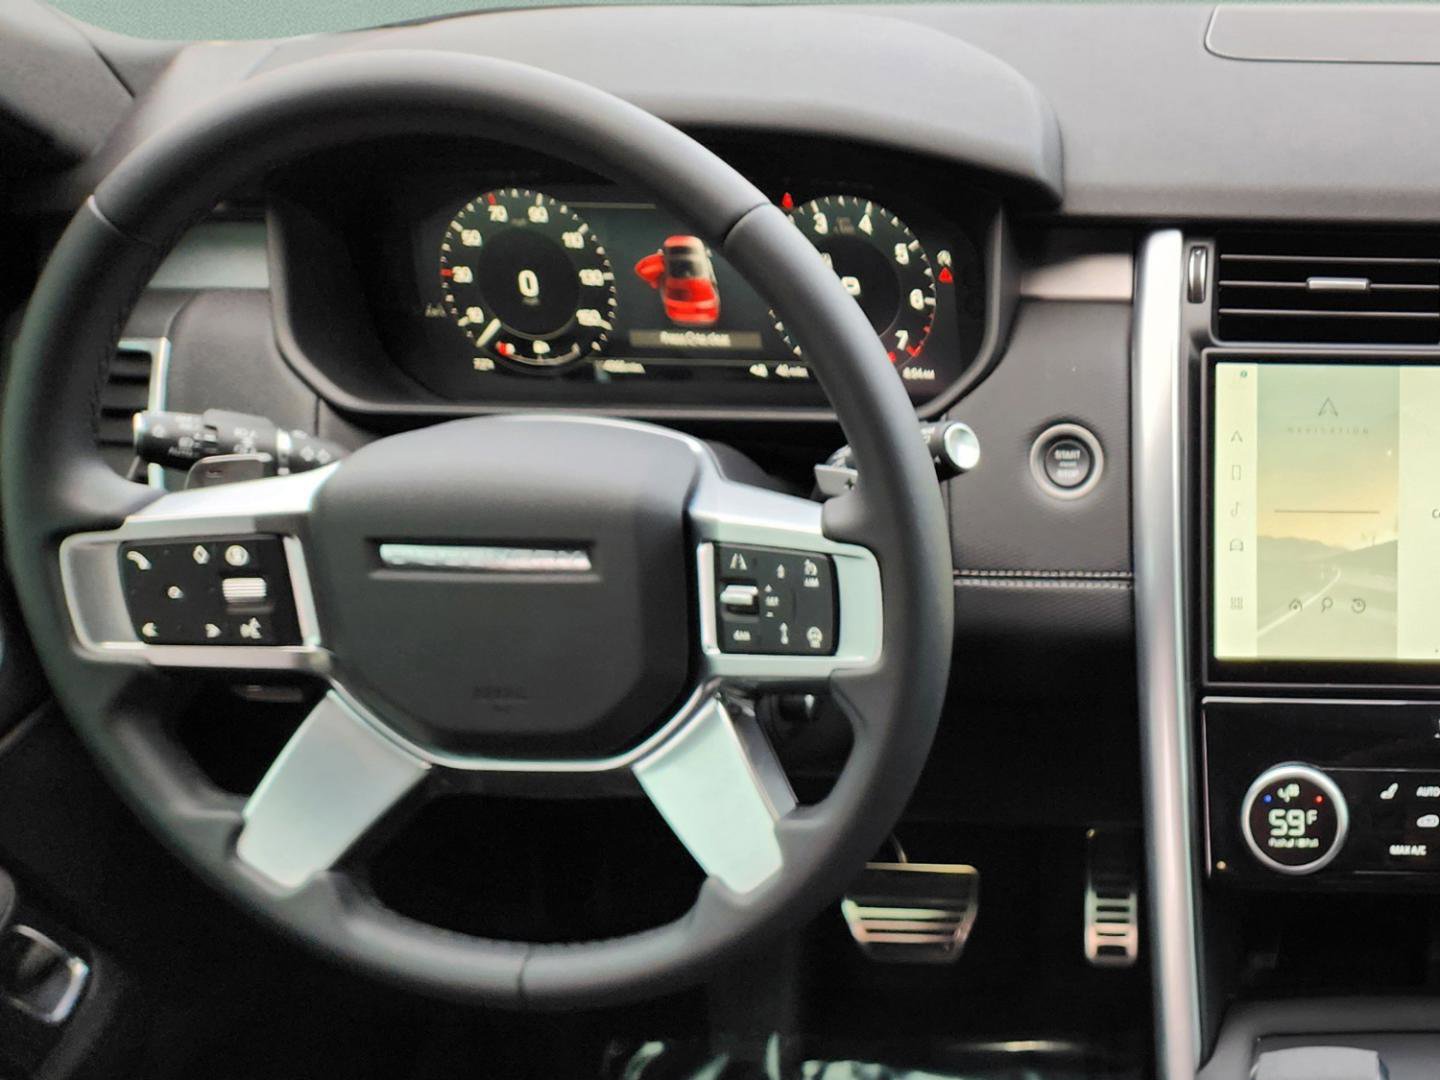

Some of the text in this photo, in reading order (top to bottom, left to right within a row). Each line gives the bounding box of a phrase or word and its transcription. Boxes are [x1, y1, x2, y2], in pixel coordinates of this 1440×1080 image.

[813, 212, 828, 235] 3
[858, 214, 872, 235] 4
[895, 243, 909, 265] 5
[518, 270, 539, 297] 0
[909, 289, 924, 310] 6
[895, 330, 909, 351] 7
[1416, 786, 1440, 797] AUTO
